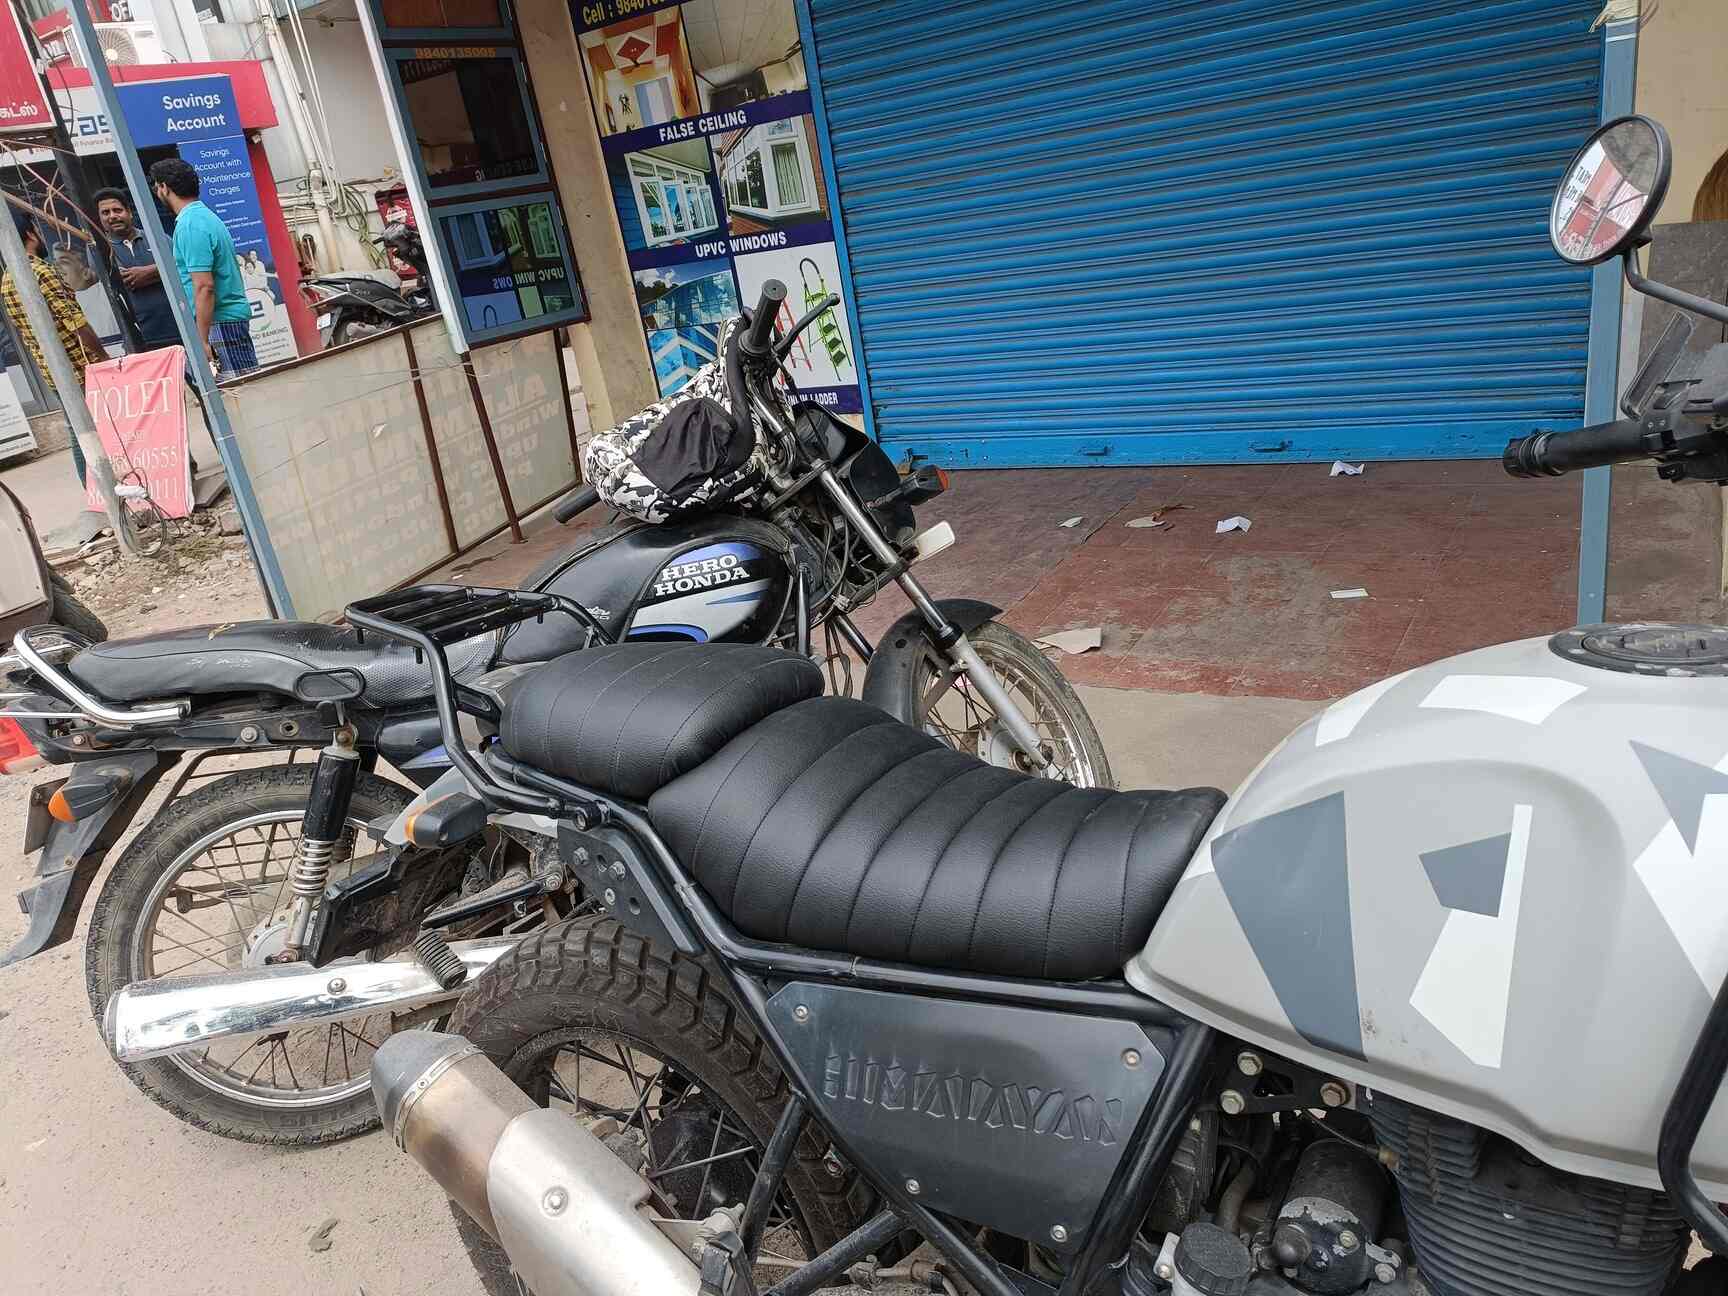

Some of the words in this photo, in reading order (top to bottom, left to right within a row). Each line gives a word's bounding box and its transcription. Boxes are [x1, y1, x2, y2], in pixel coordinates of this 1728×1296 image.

[583, 2, 606, 25] Cell
[162, 93, 222, 111] Savings
[166, 113, 227, 133] Account
[659, 122, 696, 142] FALSE
[698, 109, 748, 133] CEILING
[200, 149, 230, 159] Savings
[194, 161, 225, 171] Account
[226, 159, 242, 169] with
[203, 171, 252, 184] Maintenance
[208, 186, 241, 197] Charges
[695, 241, 727, 258] UPVC
[729, 231, 788, 253] WINDOWS
[661, 554, 738, 582] HERO
[654, 567, 750, 596] HONDA
[823, 1052, 1124, 1146] HIMALAYAN
